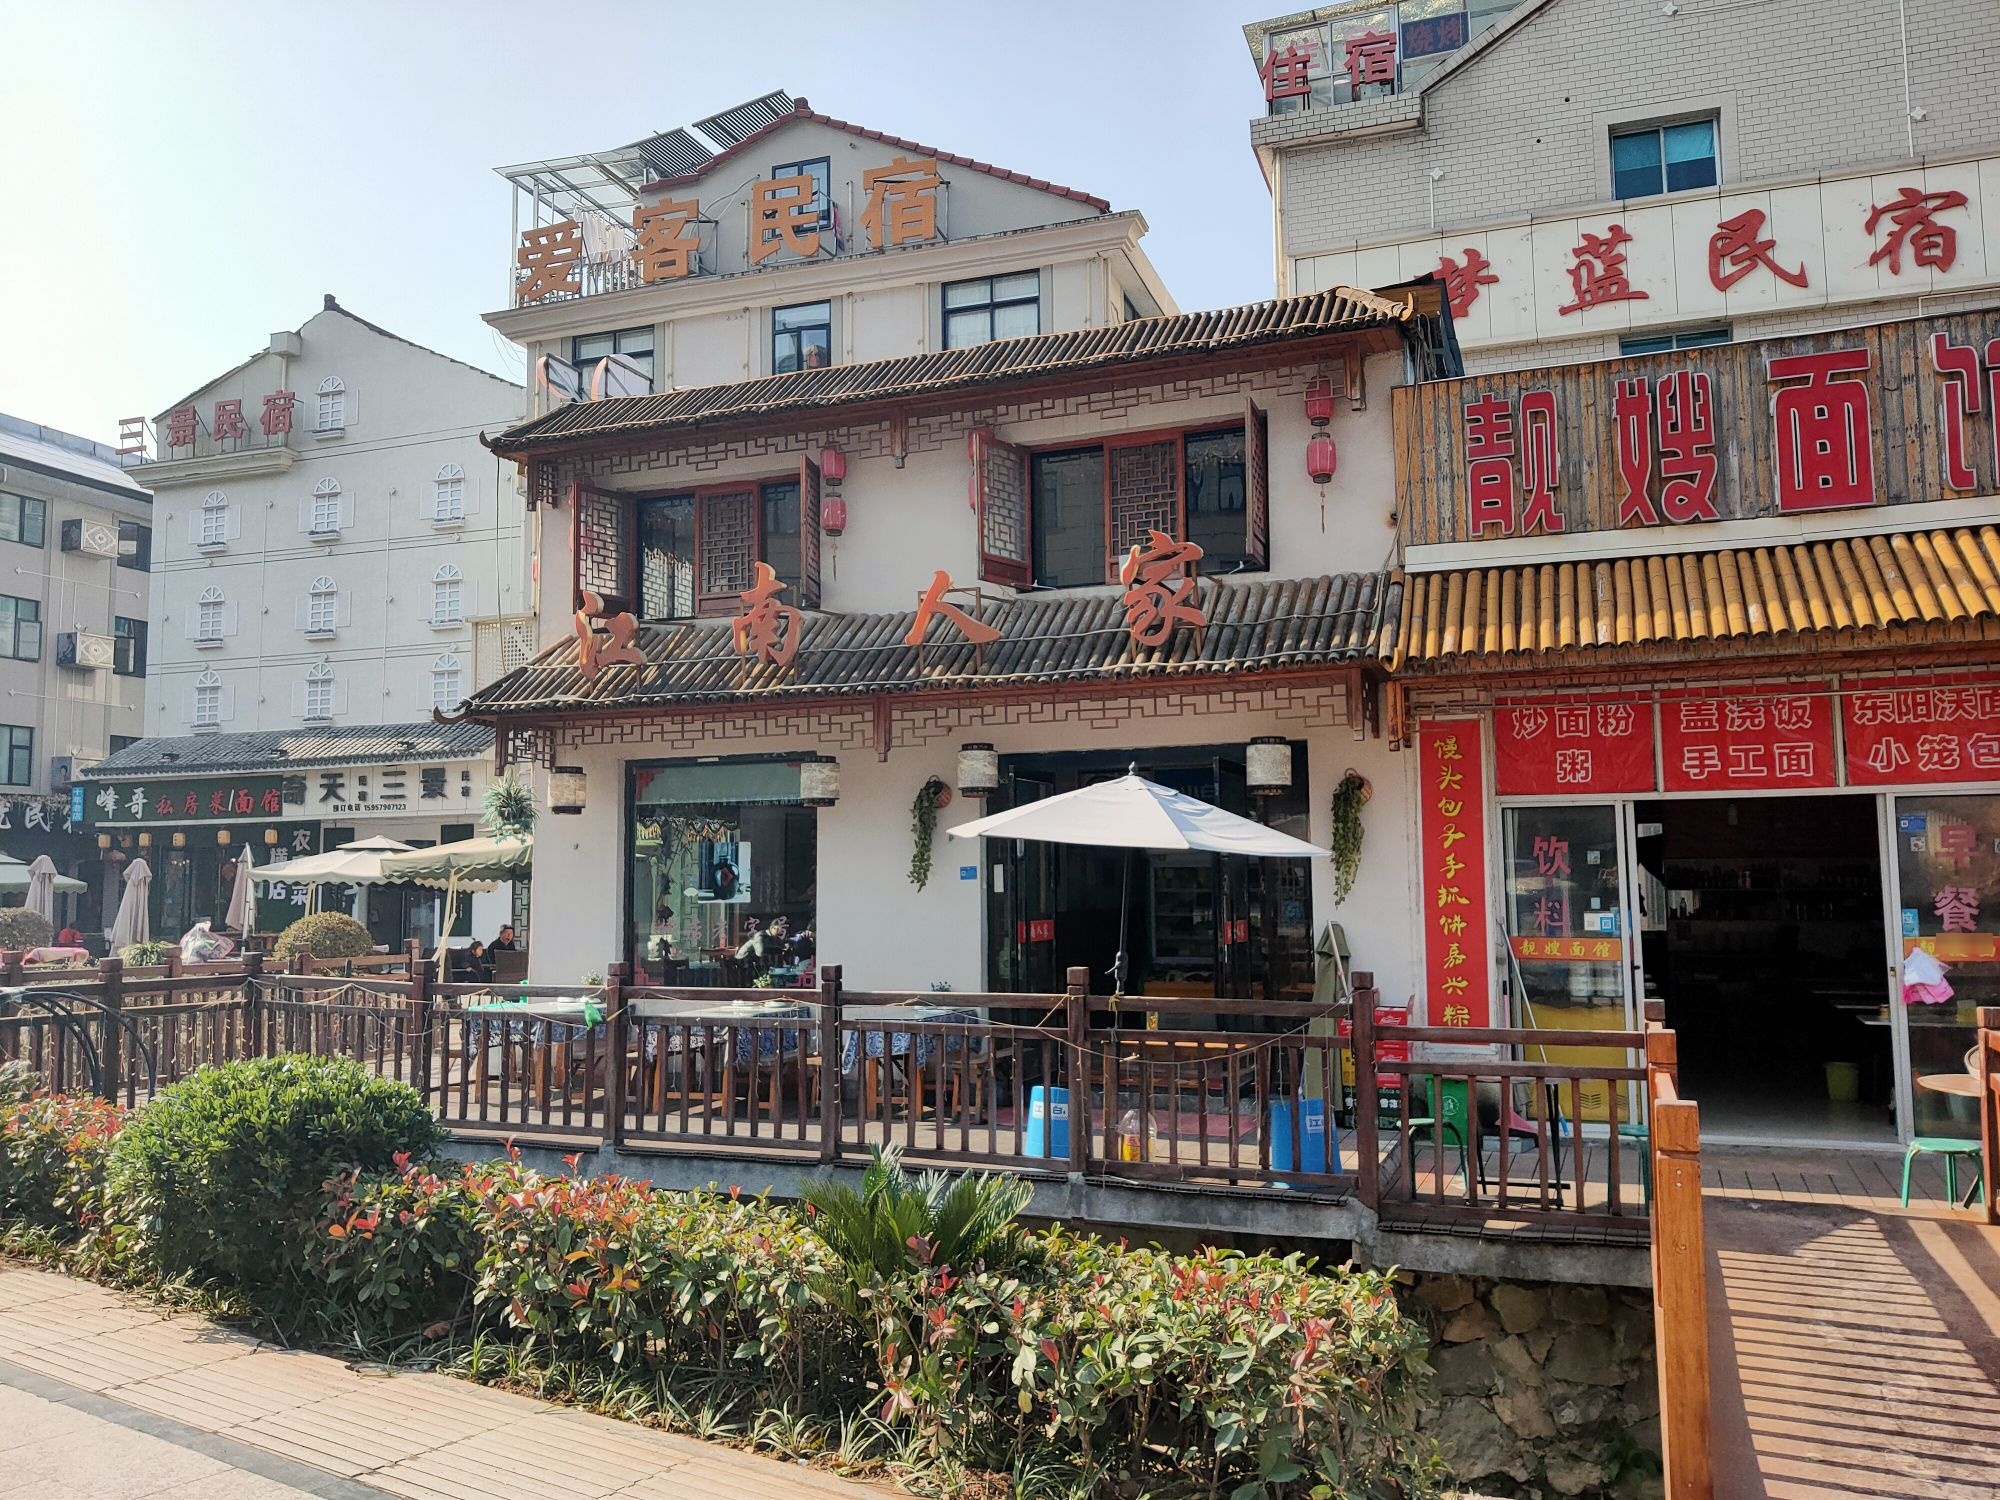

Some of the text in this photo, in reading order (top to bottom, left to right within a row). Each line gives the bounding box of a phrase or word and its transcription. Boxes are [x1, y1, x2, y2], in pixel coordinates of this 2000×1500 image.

[1260, 31, 1397, 102] 住宿
[516, 155, 940, 300] 爱客民宿
[1417, 187, 1969, 318] 梦蓝民宿
[115, 390, 296, 456] 三景民宿
[575, 529, 1208, 679] 江南人家
[1512, 703, 1635, 740] 炒面粉
[1680, 697, 1812, 733] 盖浇饭
[1557, 750, 1592, 783] 粥
[1683, 742, 1814, 779] 手工面
[1868, 733, 2000, 773] 小笼包
[380, 768, 448, 799] 三景
[1532, 835, 1572, 937] 饮料
[1934, 824, 1981, 932] 早餐
[1519, 939, 1611, 958] 靓嫂面馆
